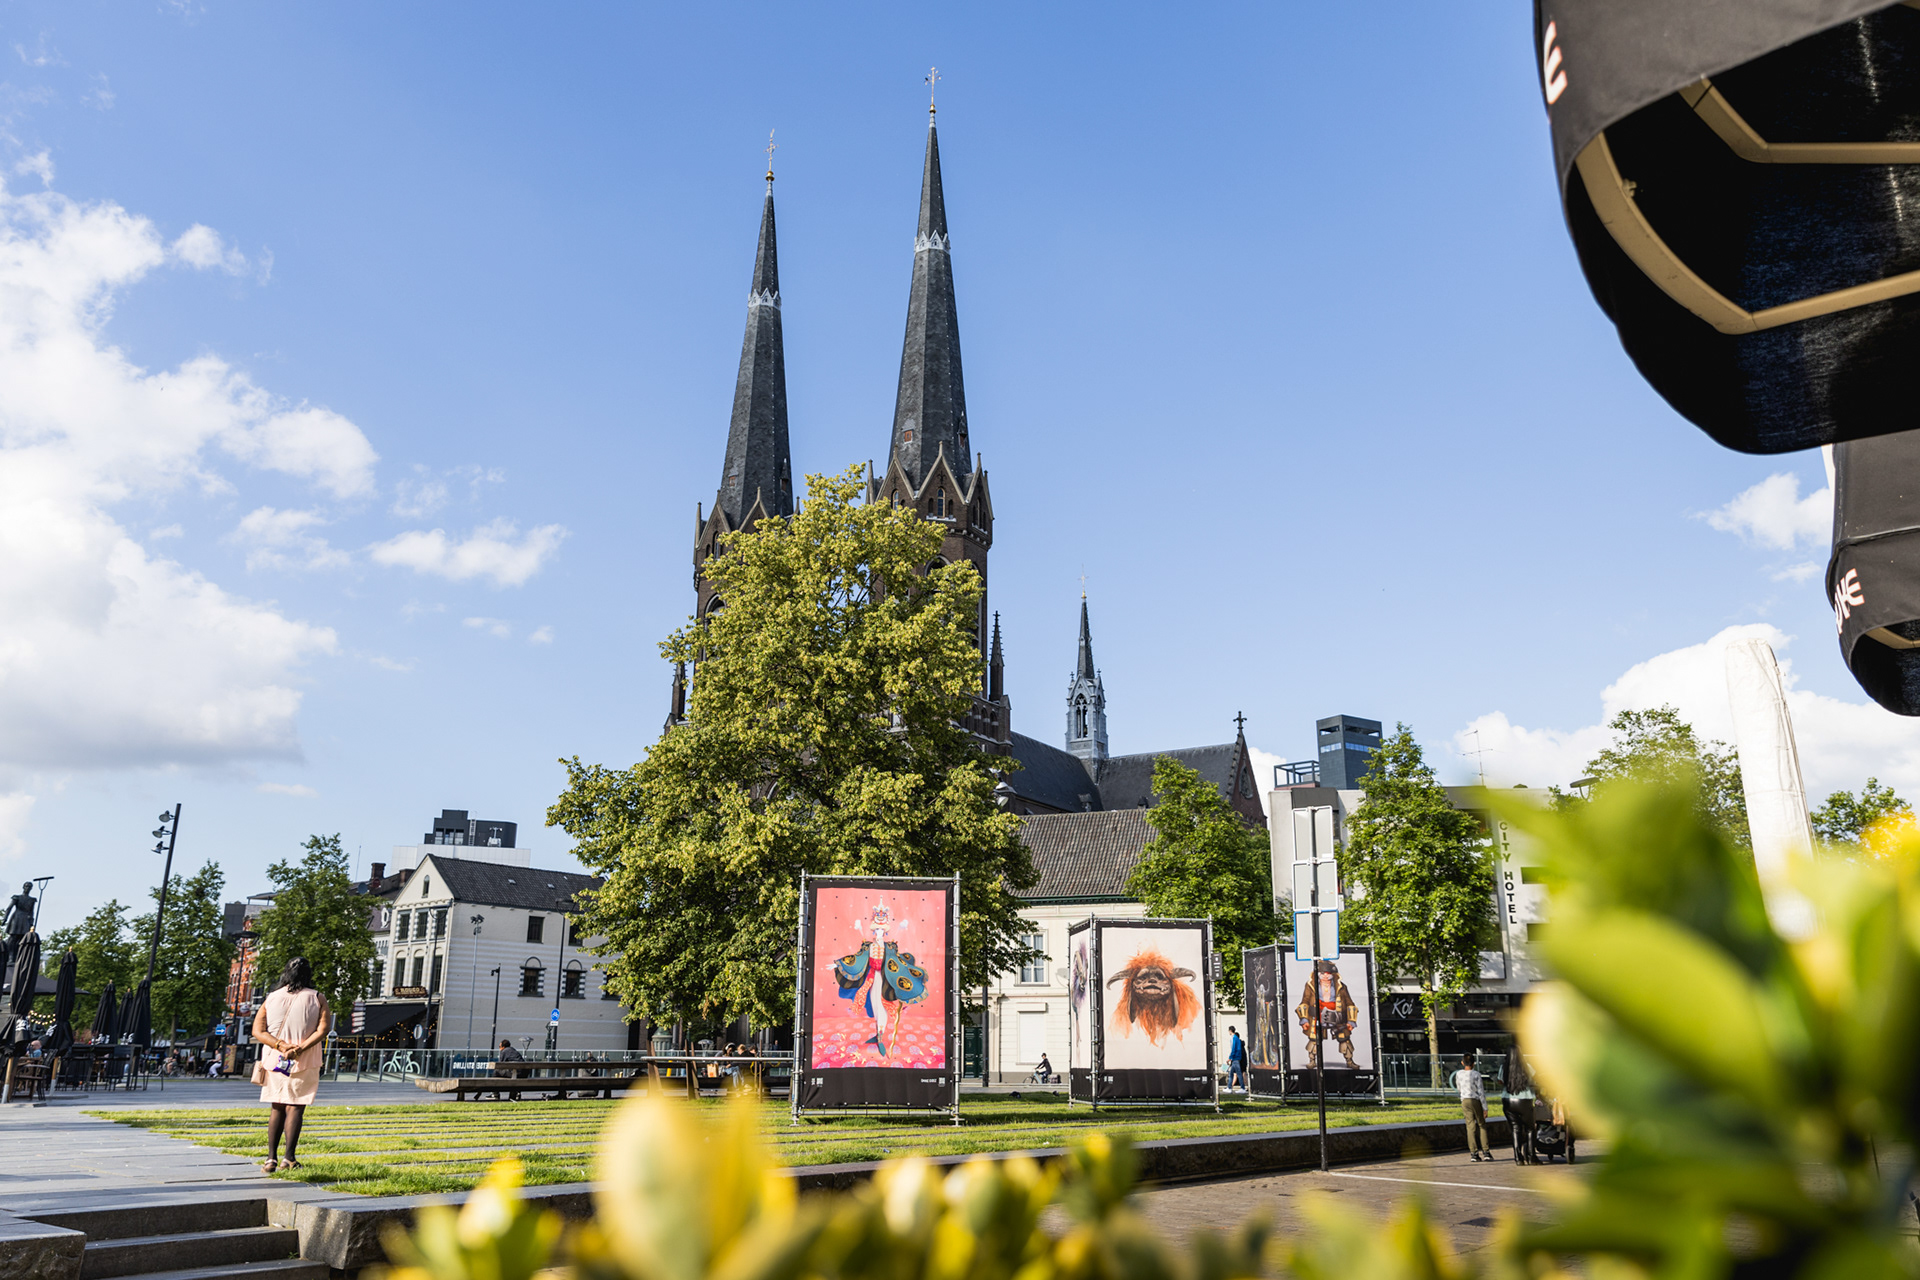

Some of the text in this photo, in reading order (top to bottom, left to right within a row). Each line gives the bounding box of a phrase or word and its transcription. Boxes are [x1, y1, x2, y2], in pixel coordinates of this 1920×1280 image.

[1499, 821, 1511, 862] CITY
[1504, 871, 1517, 924] HOTEL
[1391, 997, 1414, 1019] Koi
